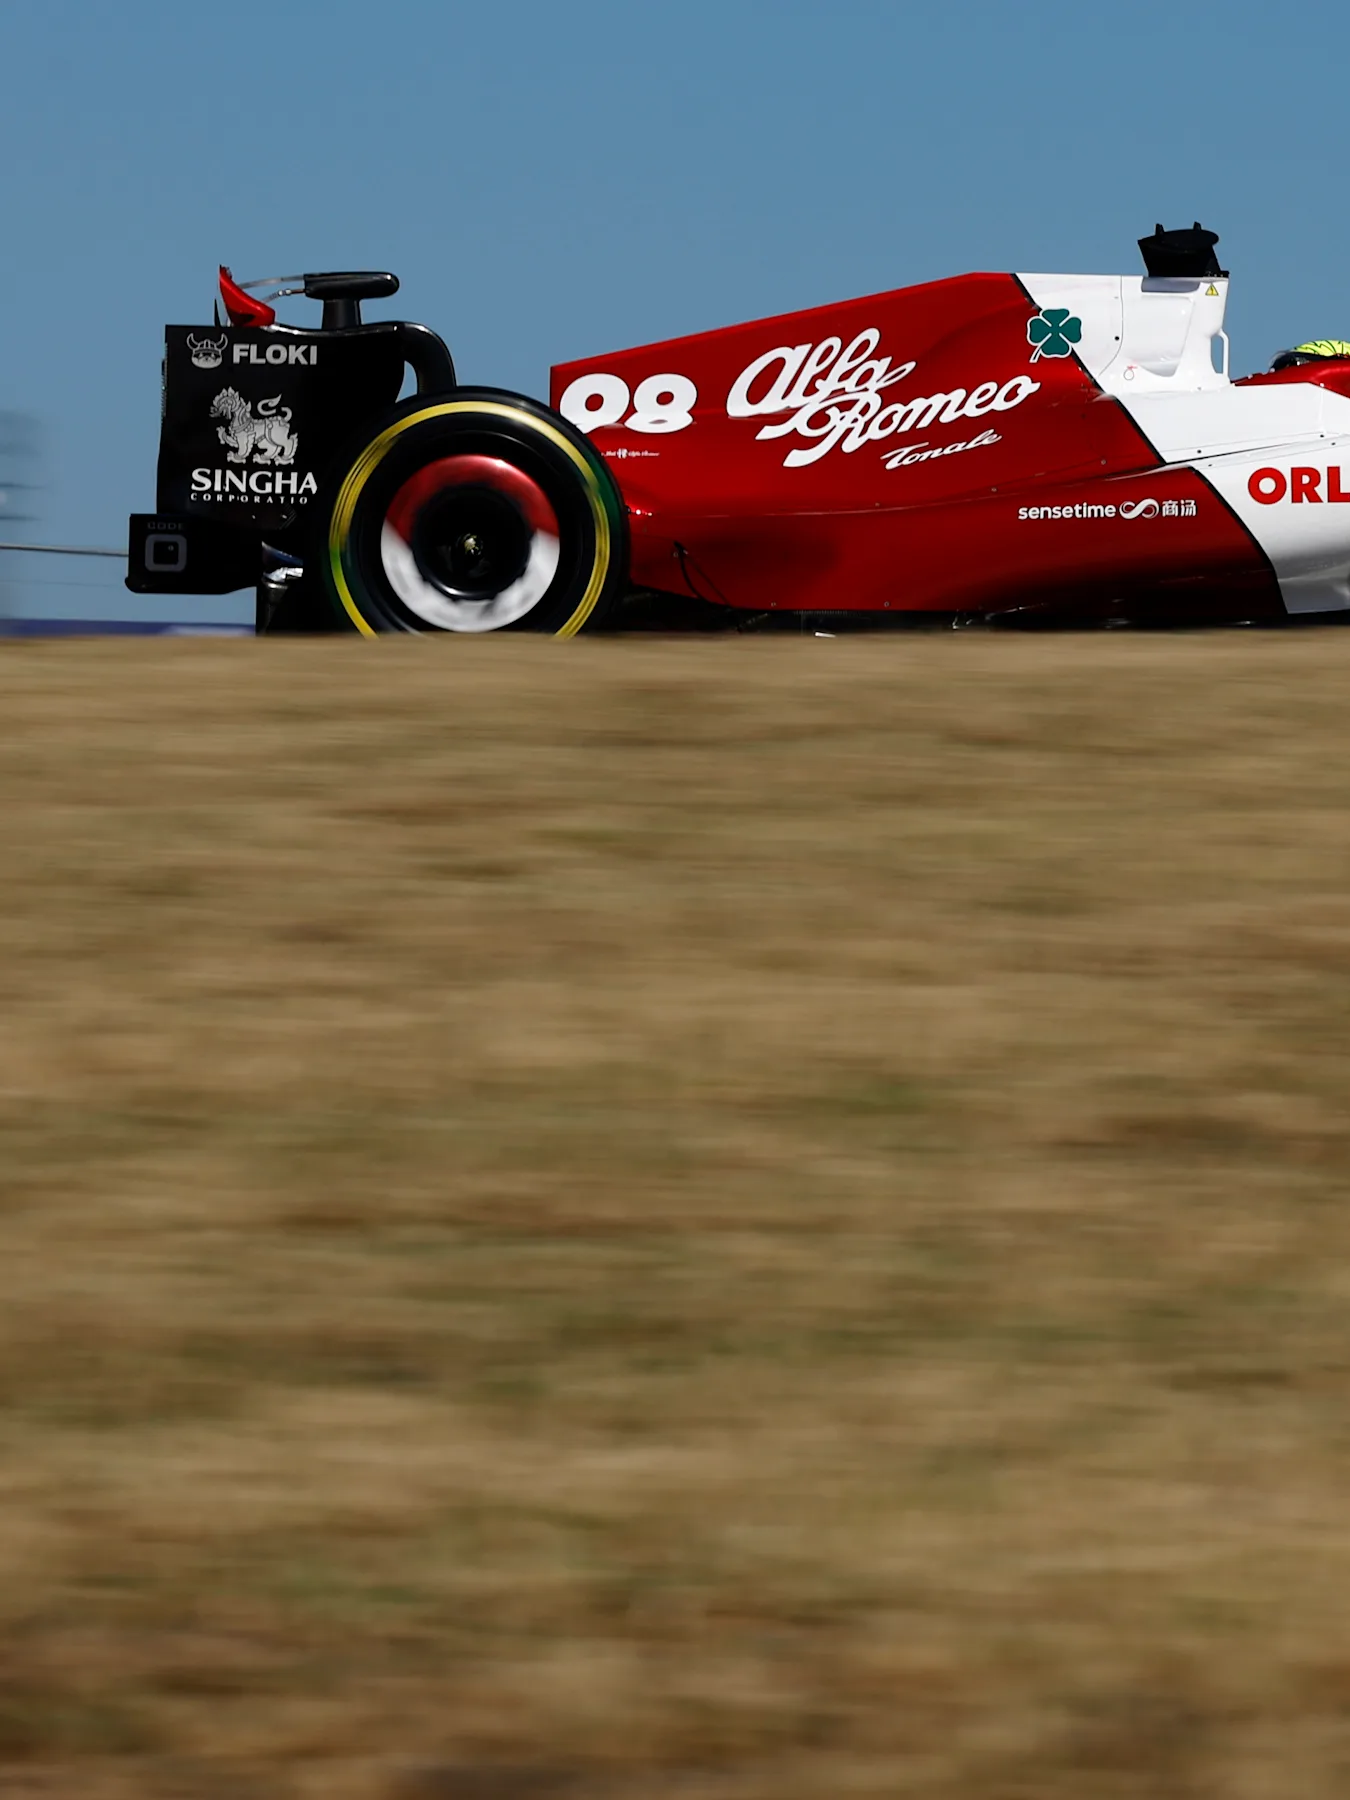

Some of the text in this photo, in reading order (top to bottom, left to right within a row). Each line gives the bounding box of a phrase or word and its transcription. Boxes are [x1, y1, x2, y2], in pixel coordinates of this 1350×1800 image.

[232, 343, 318, 366] FLOKI
[726, 328, 916, 418] Alfa
[560, 373, 698, 434] 98
[755, 375, 1041, 468] Romeo
[880, 428, 1002, 470] Tonale
[191, 467, 318, 495] SINGHA
[1018, 502, 1116, 520] sensetime
[1162, 500, 1197, 517] 商汤
